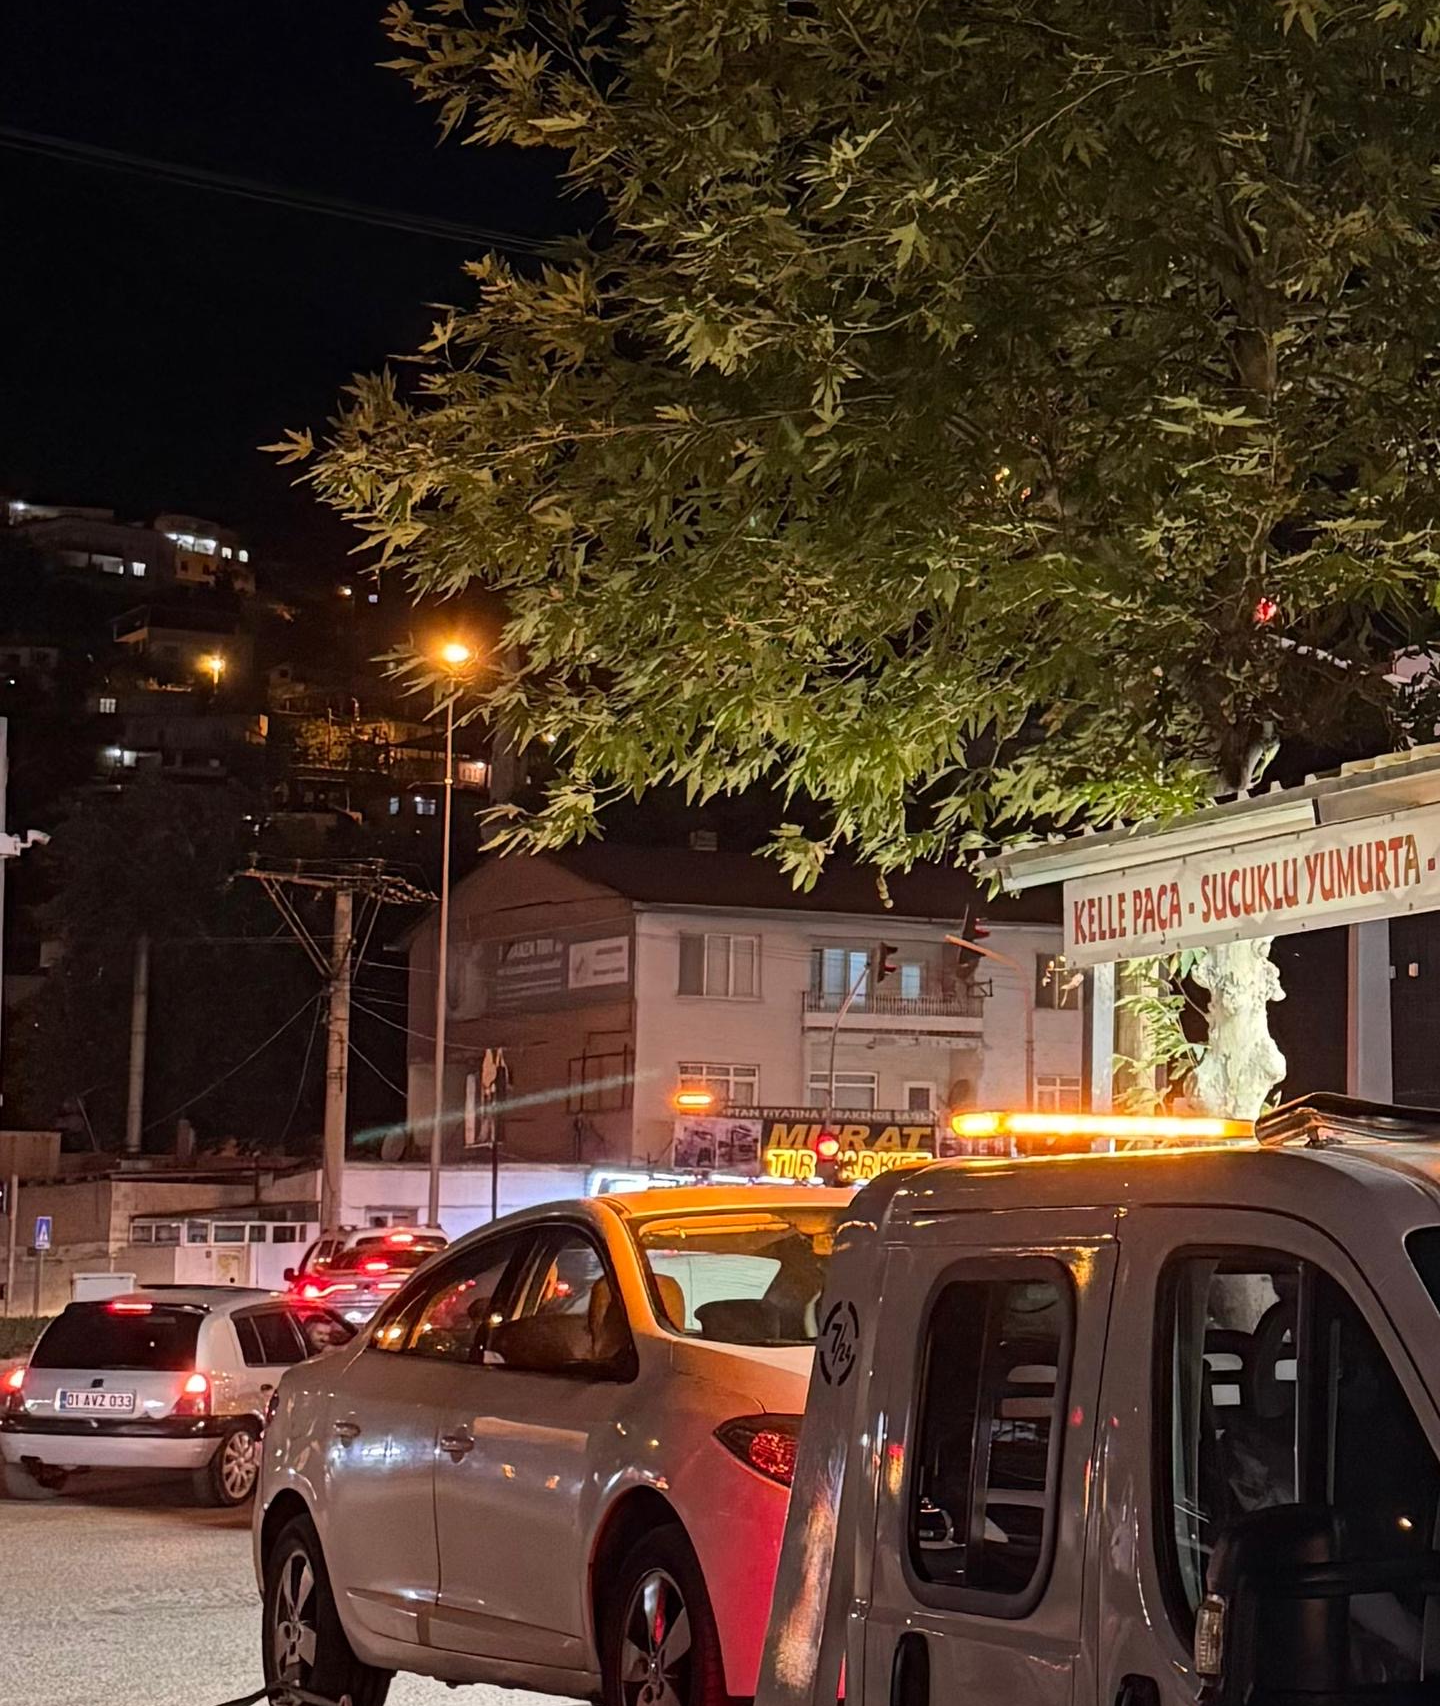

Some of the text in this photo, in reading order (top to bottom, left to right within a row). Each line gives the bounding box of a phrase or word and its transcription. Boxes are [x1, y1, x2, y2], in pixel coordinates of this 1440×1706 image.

[1073, 892, 1127, 945] KELLE
[1132, 882, 1183, 945] PAÇA
[1200, 857, 1300, 924] SUCUKLU
[1304, 834, 1421, 905] YUMURTA
[767, 1149, 818, 1179] TIR
[83, 1394, 106, 1407] AVZ
[109, 1395, 132, 1408] 033
